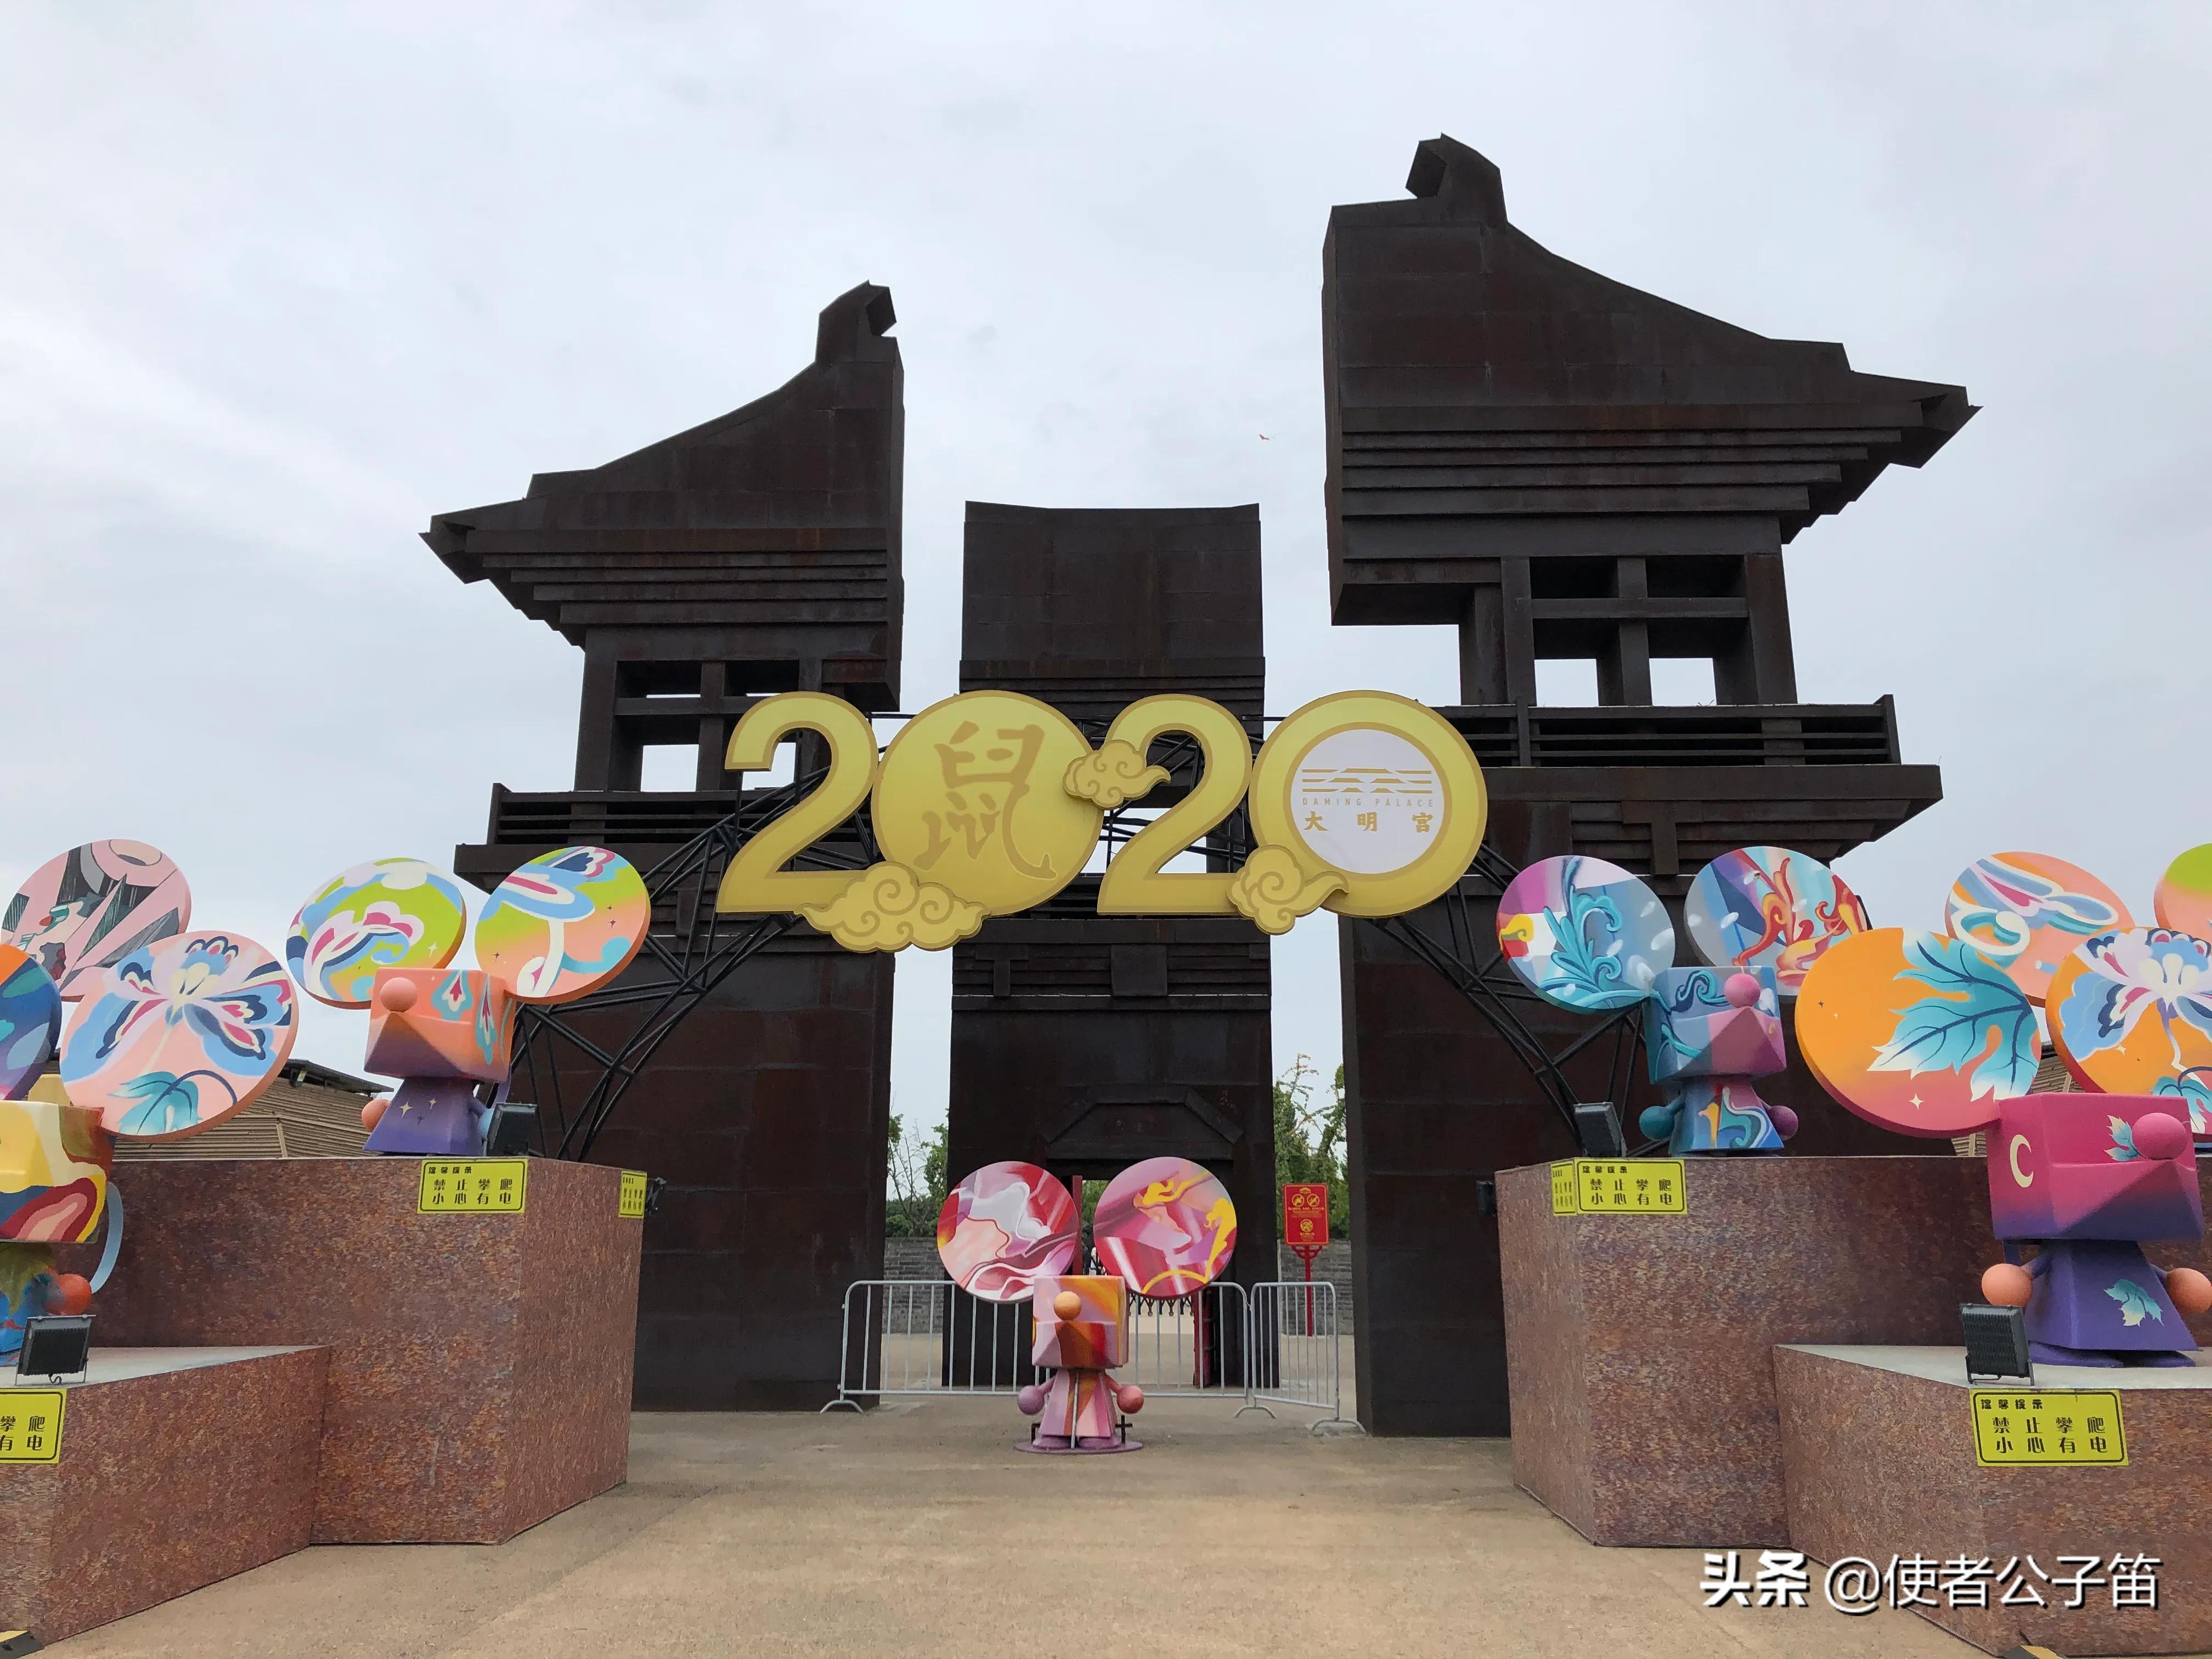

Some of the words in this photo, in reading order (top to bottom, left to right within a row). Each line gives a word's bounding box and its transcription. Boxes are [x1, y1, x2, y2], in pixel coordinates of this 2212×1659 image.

[913, 720, 1057, 880] 鼠
[1302, 798, 1362, 806] DAMING
[1375, 798, 1433, 807] PALACE
[434, 1178, 513, 1191] 禁止攀爬
[1590, 1178, 1672, 1192] 禁止攀爬
[432, 1192, 512, 1205] 小心有电
[1591, 1192, 1673, 1206] 小心有电
[1993, 1416, 2106, 1434] 禁止攀爬
[1996, 1436, 2108, 1454] 小心有电
